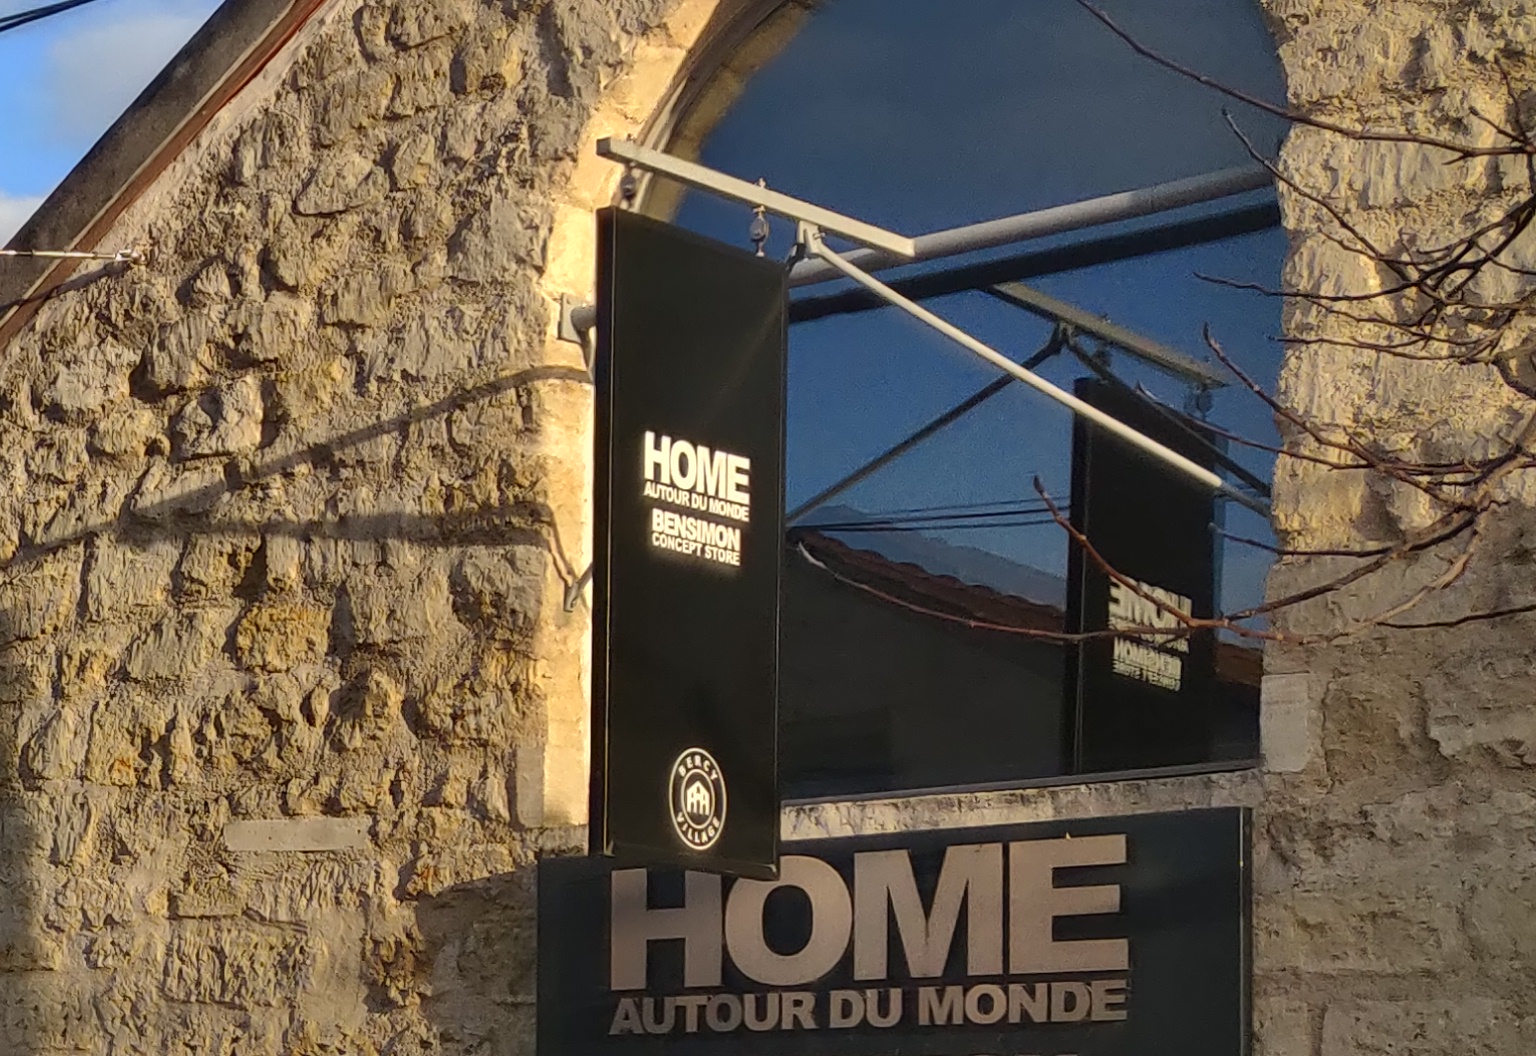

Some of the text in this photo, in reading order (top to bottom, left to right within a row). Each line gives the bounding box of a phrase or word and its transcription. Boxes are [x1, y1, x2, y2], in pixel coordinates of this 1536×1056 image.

[644, 431, 750, 505] HOME
[643, 481, 750, 522] AUTOUR DU MONDE
[652, 508, 741, 551] BENSIMON
[652, 532, 740, 566] CONCEPT STORE
[678, 755, 718, 780] BERCY
[677, 812, 720, 843] VILLAGE
[610, 834, 1129, 991] HOME
[608, 979, 1129, 1036] AUTOUR DU MONDE
